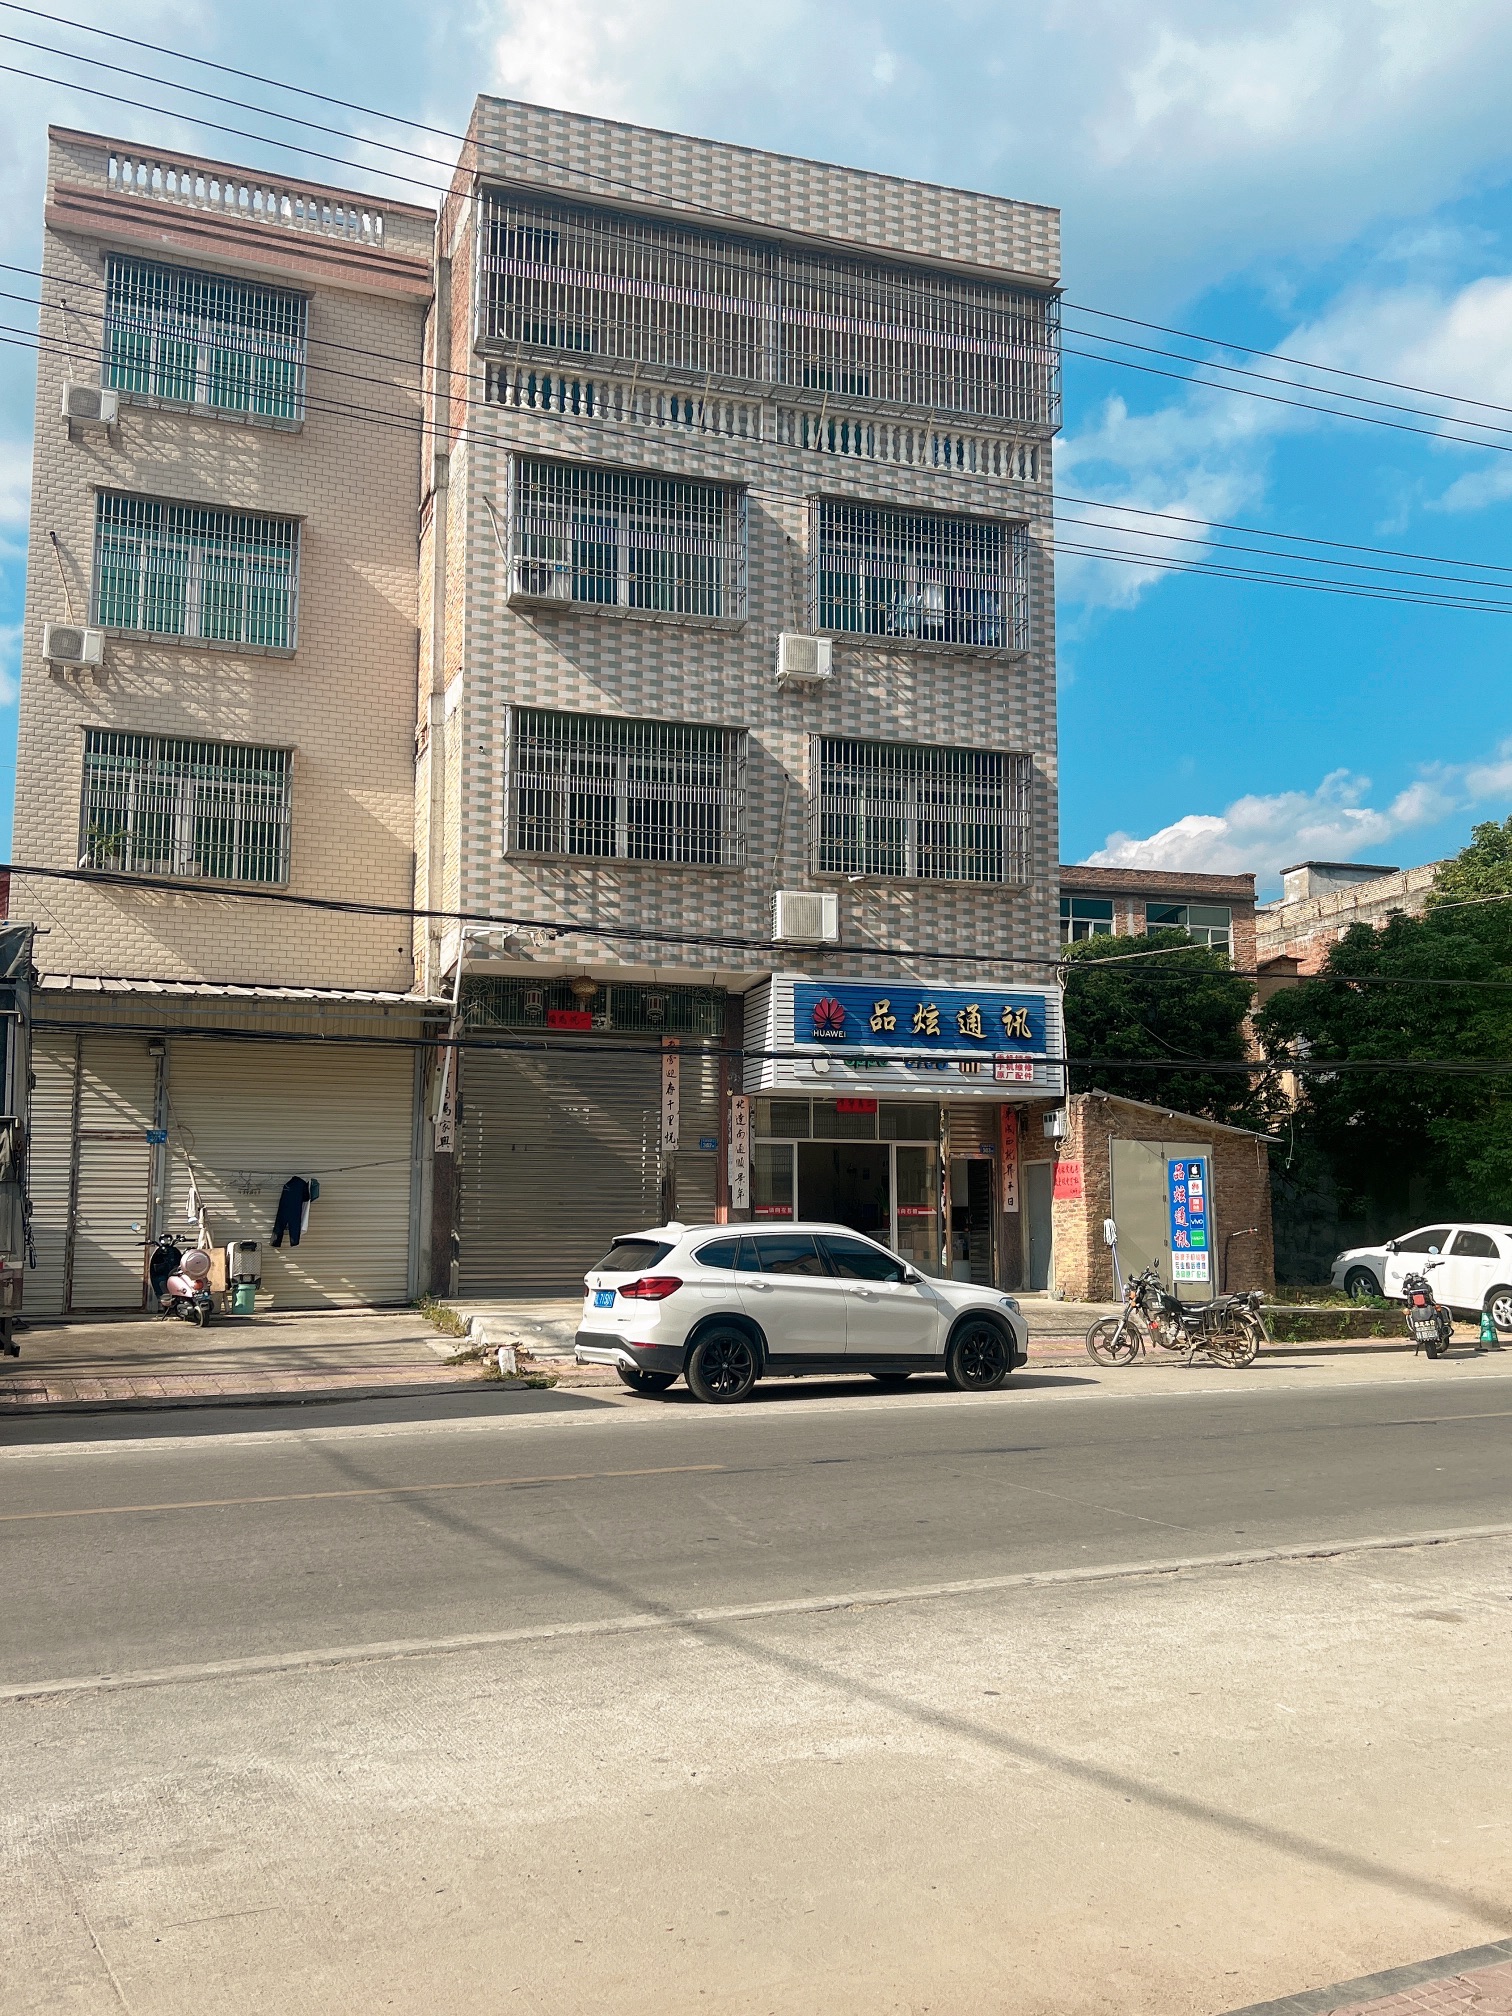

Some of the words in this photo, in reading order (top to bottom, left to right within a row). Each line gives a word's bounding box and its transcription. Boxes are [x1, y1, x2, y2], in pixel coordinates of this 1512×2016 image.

[812, 1029, 847, 1038] HUAWEI
[996, 1071, 1033, 1080] 原厂配件
